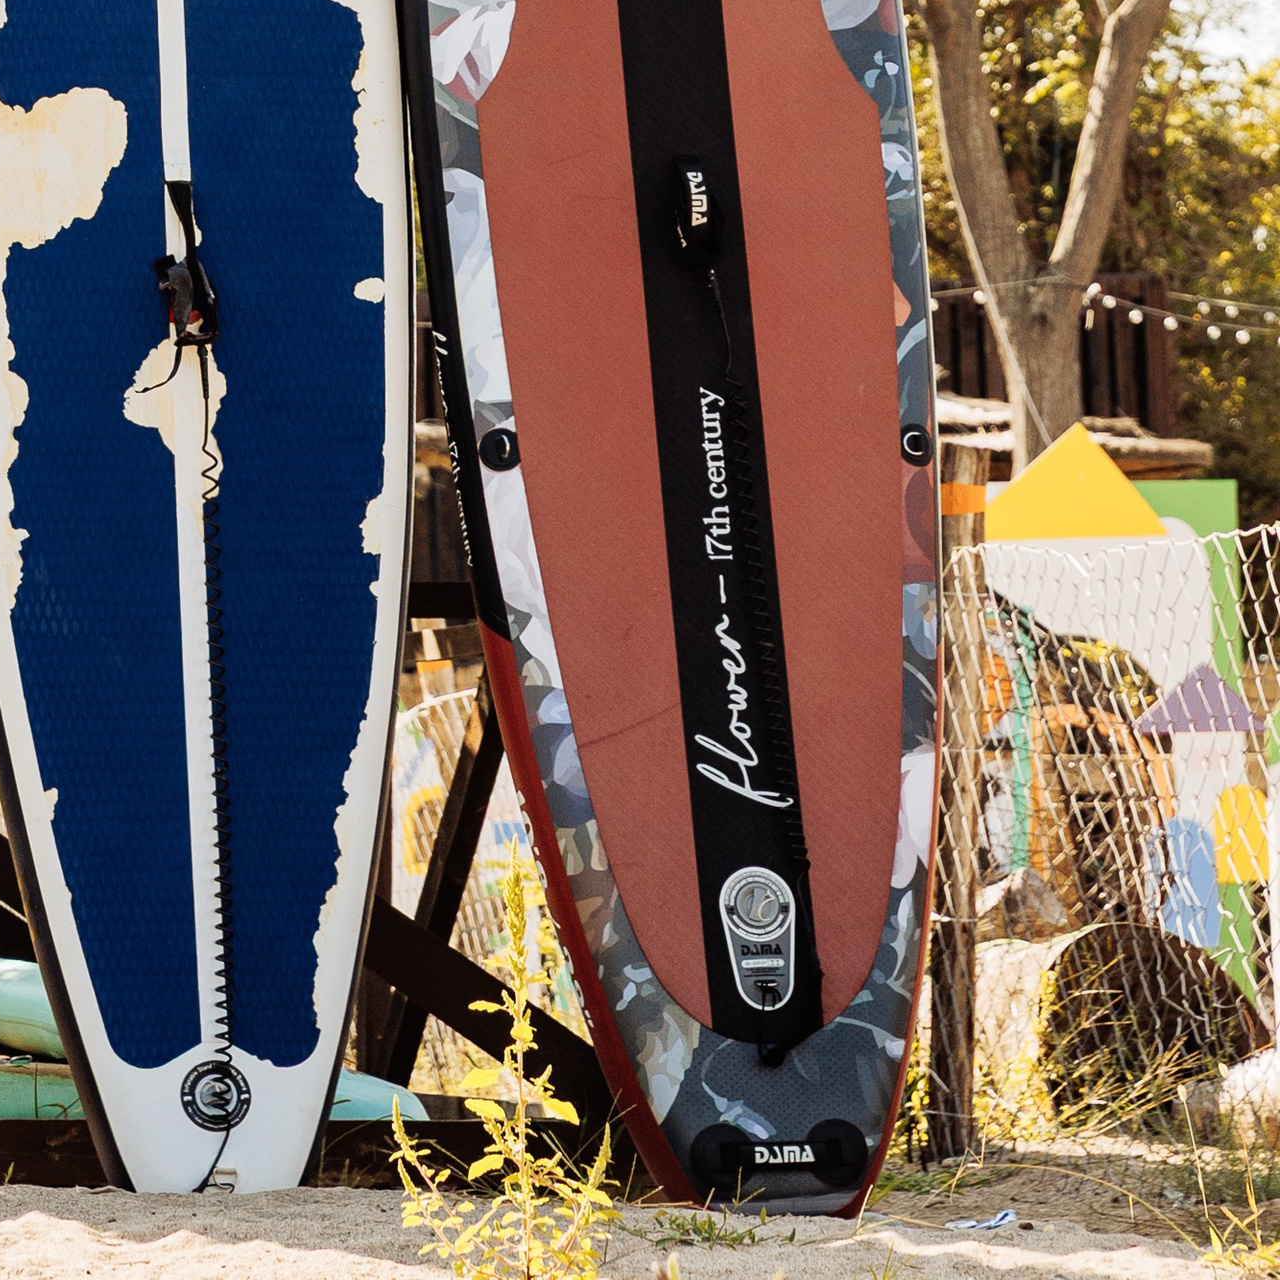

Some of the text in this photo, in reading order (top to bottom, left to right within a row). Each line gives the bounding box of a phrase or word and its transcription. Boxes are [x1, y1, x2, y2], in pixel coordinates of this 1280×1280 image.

[686, 171, 708, 227] DAMA
[699, 385, 728, 500] century
[702, 504, 734, 561] 17th
[740, 944, 783, 956] DAMA
[754, 1144, 816, 1164] DAMA
